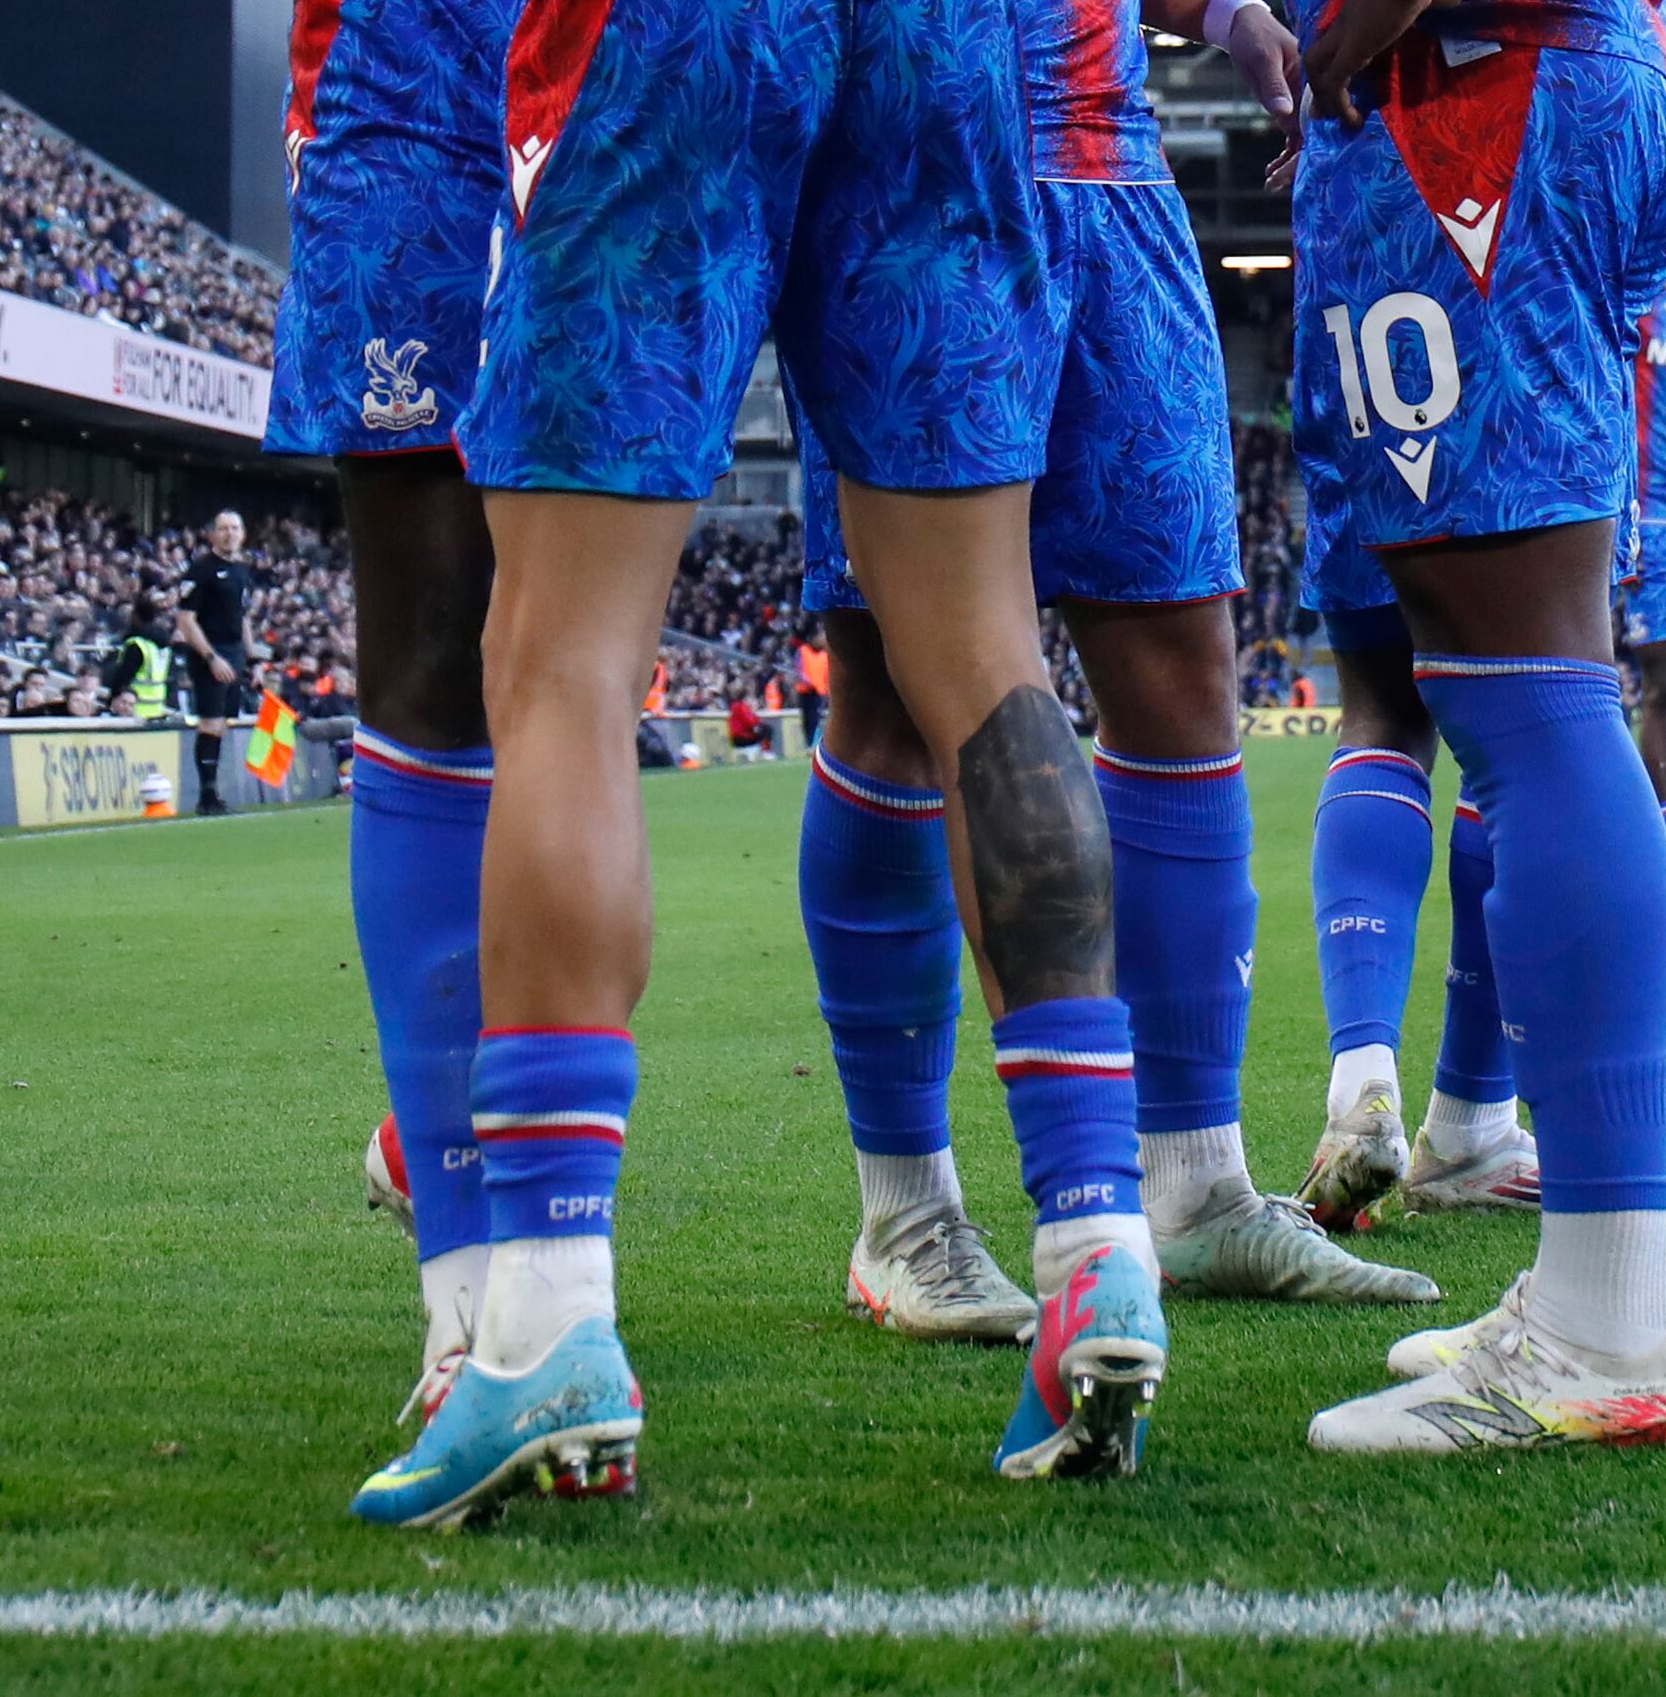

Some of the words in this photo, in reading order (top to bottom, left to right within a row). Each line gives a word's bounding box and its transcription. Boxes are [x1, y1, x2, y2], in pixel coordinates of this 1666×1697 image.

[1323, 291, 1461, 439] 10
[1329, 916, 1386, 935] CPFC
[1056, 1184, 1115, 1211] CPFC
